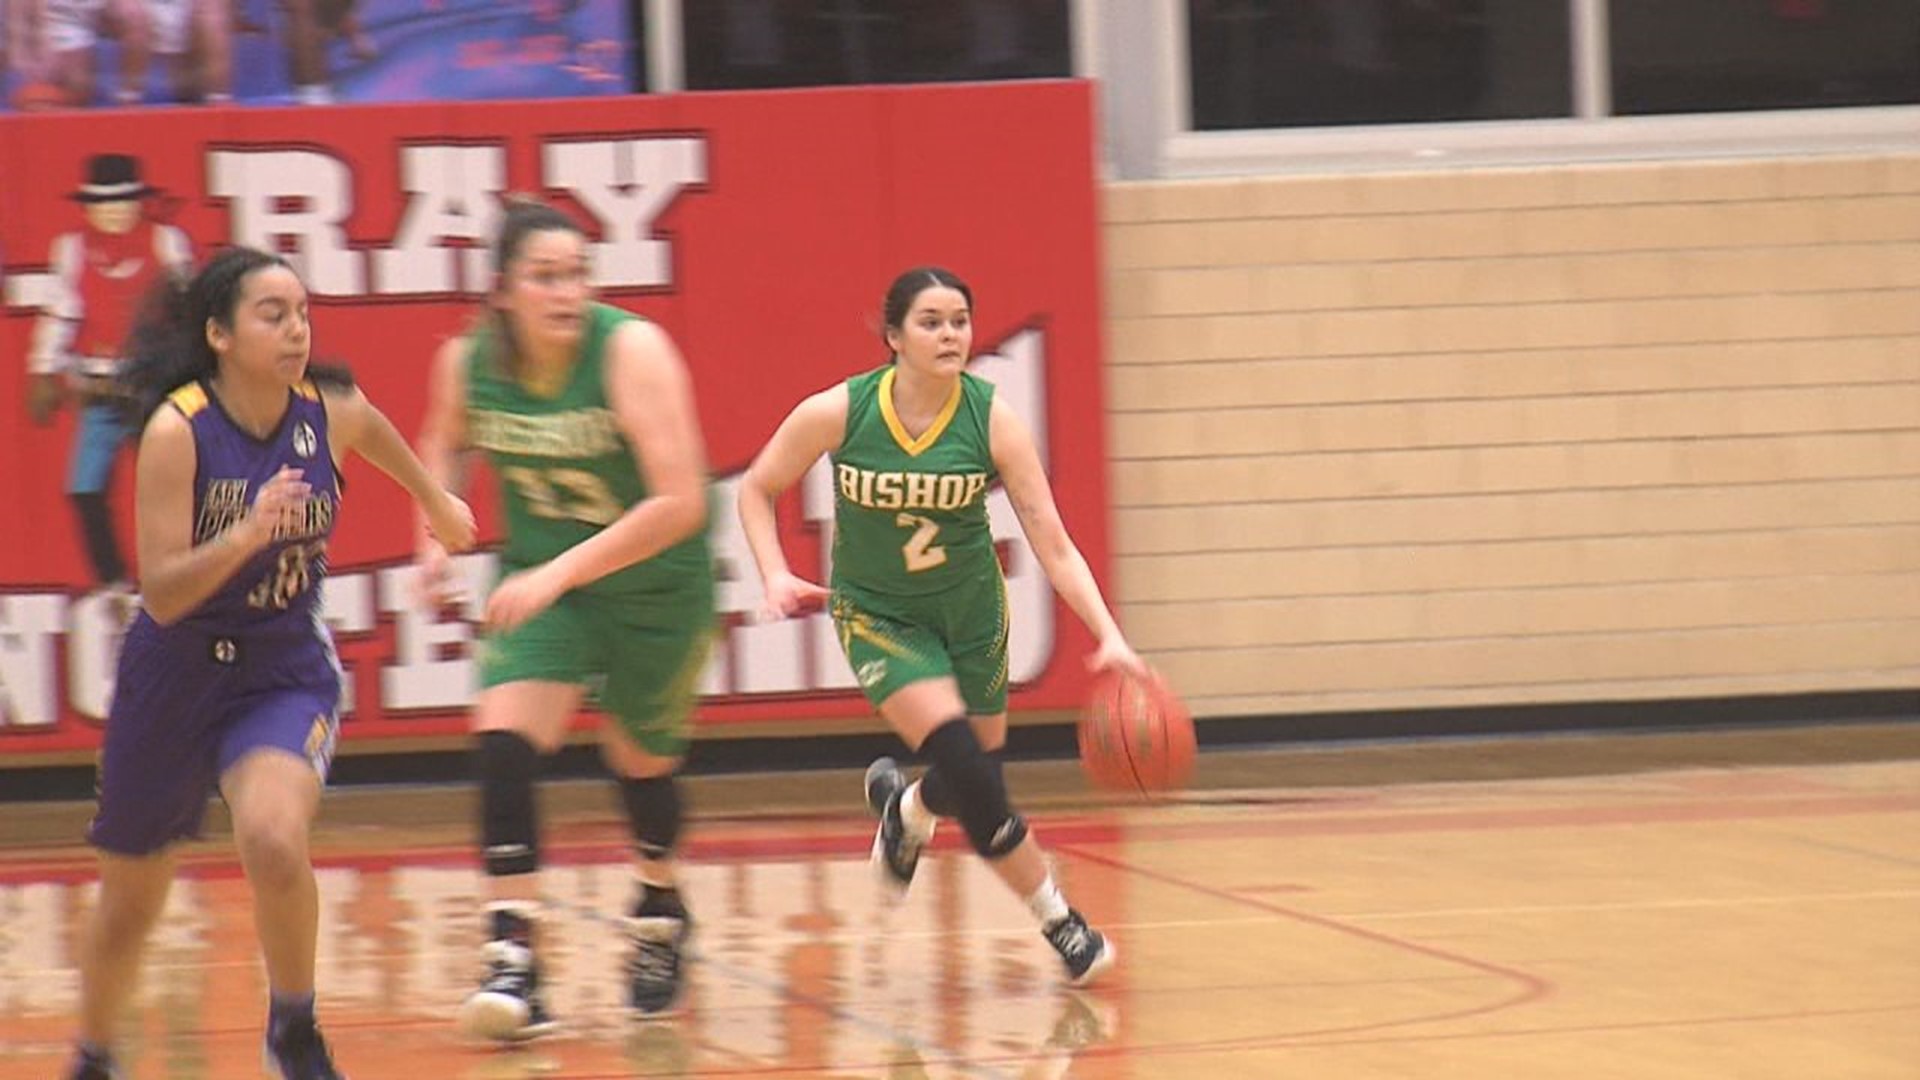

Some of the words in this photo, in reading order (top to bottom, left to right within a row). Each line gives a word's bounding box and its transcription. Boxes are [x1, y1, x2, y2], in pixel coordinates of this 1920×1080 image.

[206, 132, 709, 300] RAY
[837, 463, 987, 511] BISHOP
[896, 512, 947, 573] 2
